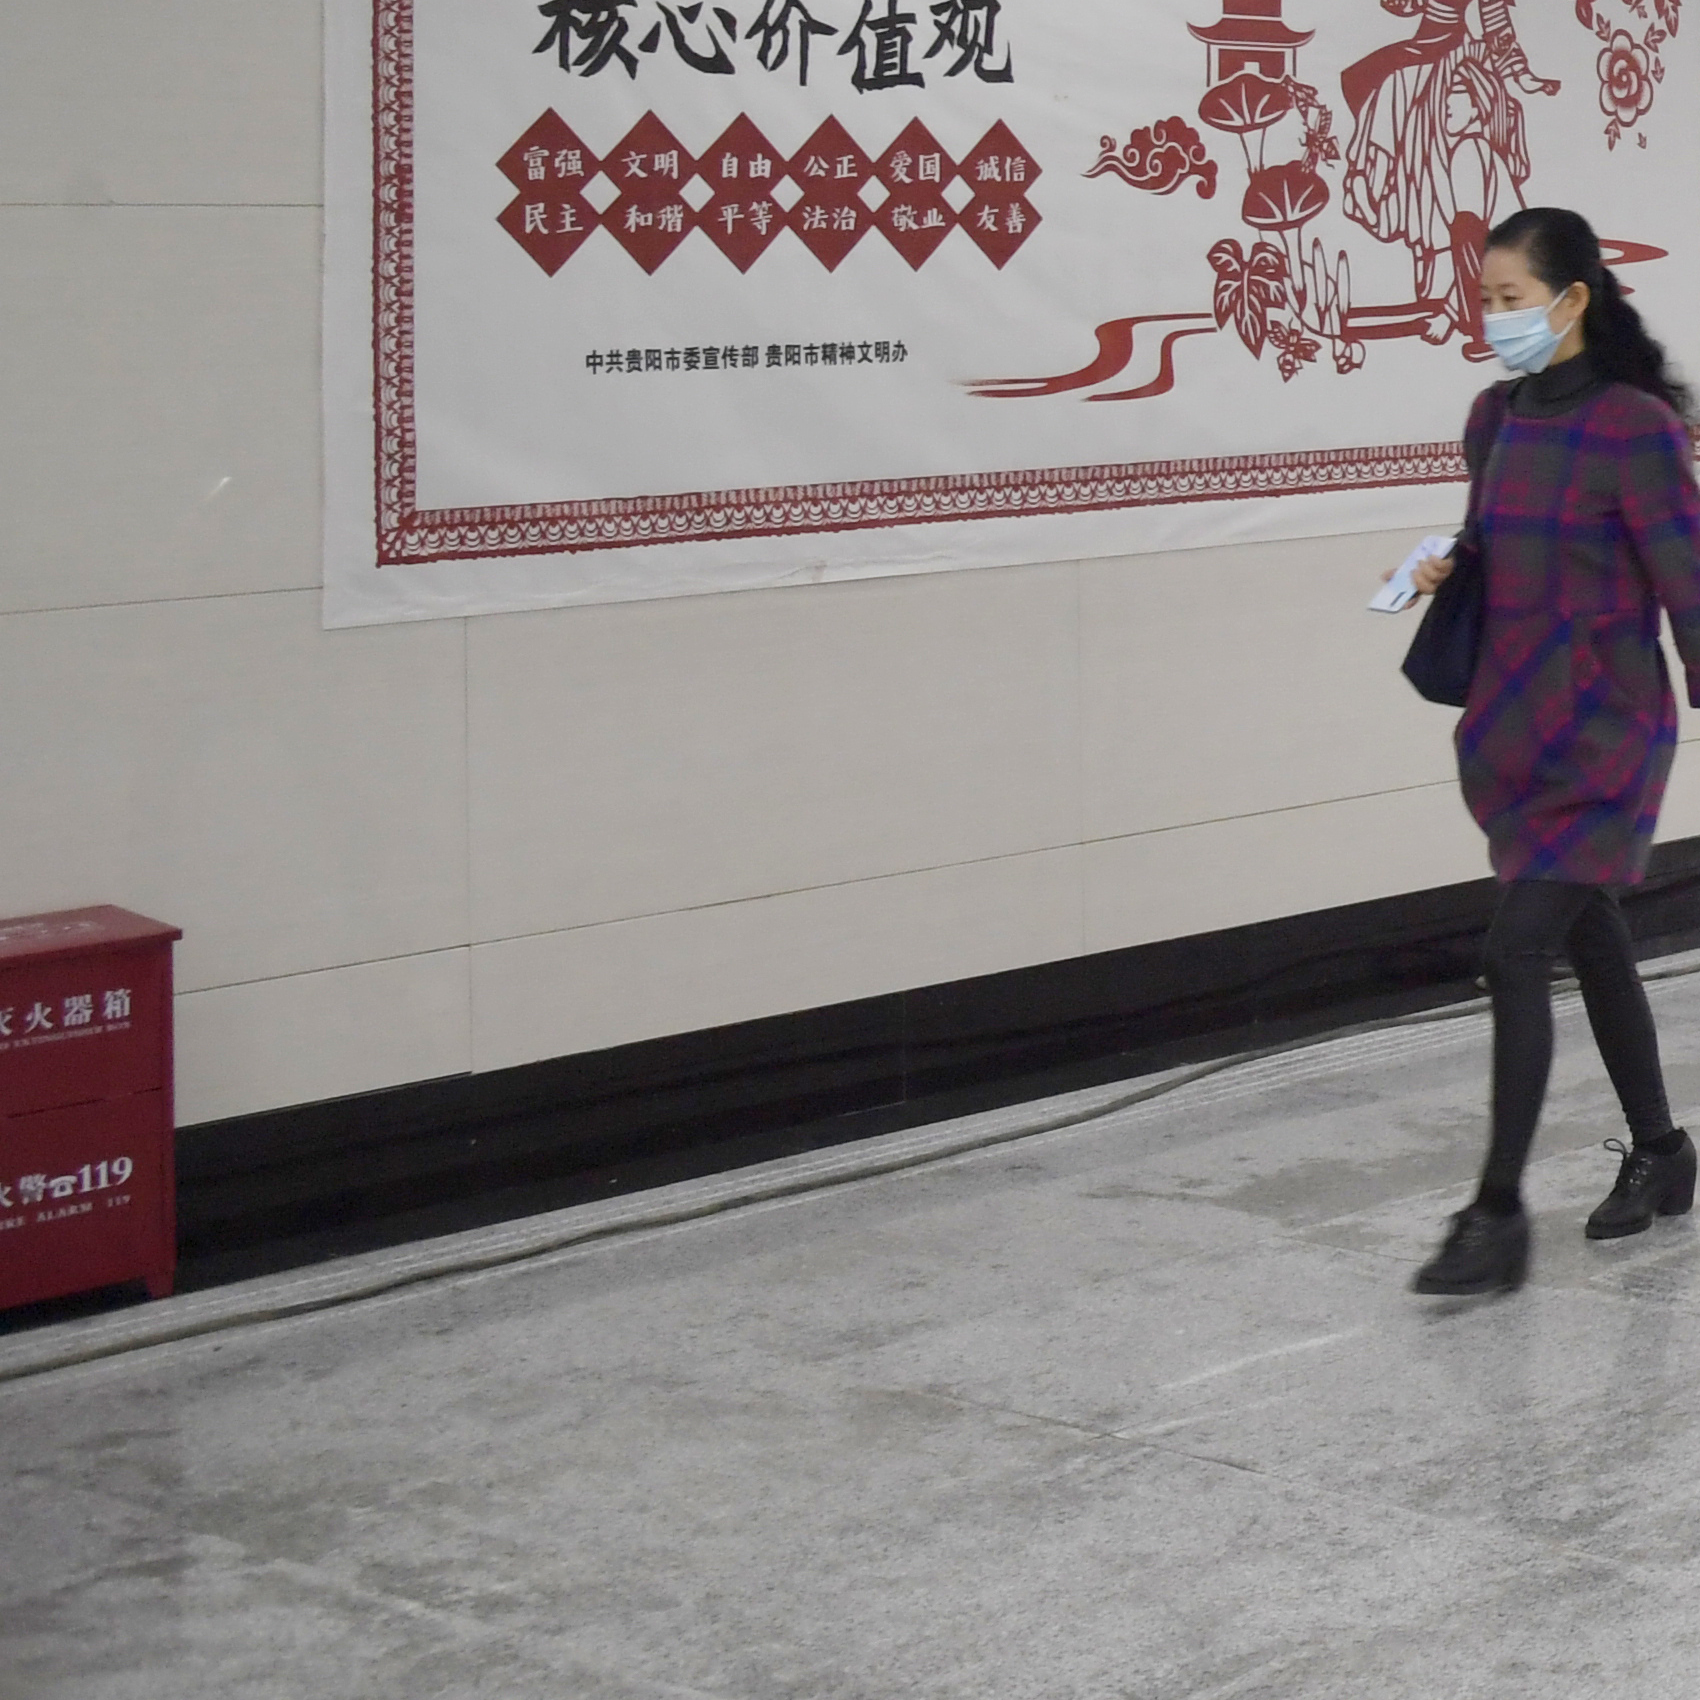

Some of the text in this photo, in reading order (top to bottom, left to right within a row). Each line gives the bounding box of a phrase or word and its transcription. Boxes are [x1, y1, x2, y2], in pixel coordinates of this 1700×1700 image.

[522, 146, 1027, 184] 富强 文明 自由 公正 爱国 诚信
[523, 201, 1027, 236] 民主 和谐 平等 法治 敬业 友善
[585, 339, 909, 375] 中共贵阳市委宣传部 贵阳市精神文明办
